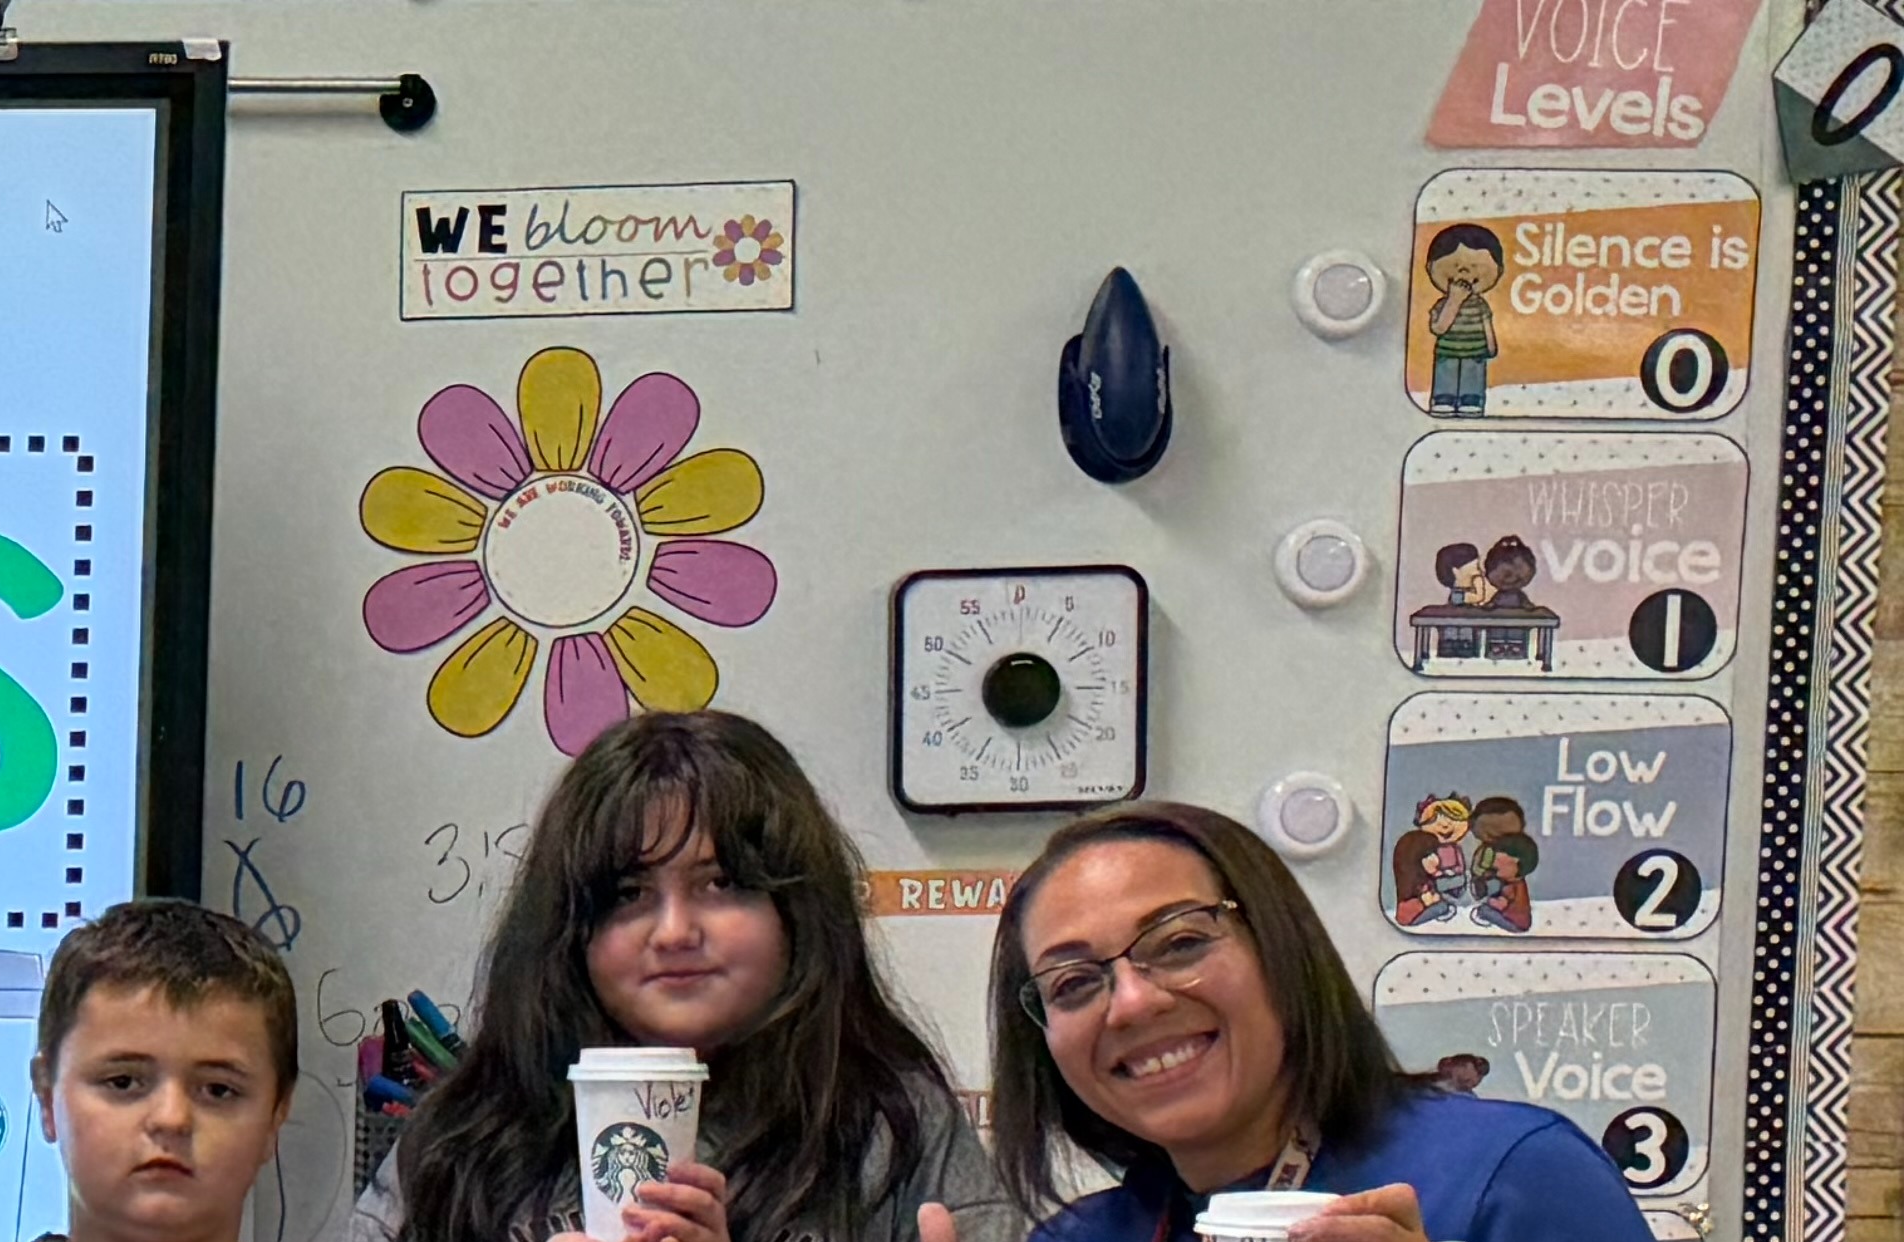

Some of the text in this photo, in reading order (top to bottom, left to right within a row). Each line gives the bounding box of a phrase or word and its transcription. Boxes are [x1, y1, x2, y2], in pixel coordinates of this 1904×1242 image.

[1514, 0, 1680, 73] VOICE
[1490, 63, 1706, 141] Levels
[415, 199, 712, 255] WE bloom
[1513, 222, 1750, 270] Silence is
[421, 257, 710, 306] together
[1508, 274, 1682, 318] Golden
[1654, 332, 1714, 408] 0
[497, 508, 518, 530] WE
[545, 480, 606, 506] WORKING
[1527, 480, 1690, 529] WHISPER
[1541, 525, 1722, 585] voice
[960, 600, 982, 616] 55
[1664, 594, 1682, 668] 1
[1098, 629, 1117, 648] 10
[1111, 681, 1130, 695] 15
[922, 731, 944, 748] 40
[1096, 727, 1116, 742] 20
[1557, 736, 1669, 786] Low
[1540, 784, 1679, 840] Flow
[899, 878, 1008, 910] REWA
[1633, 855, 1680, 929] 2
[1487, 1001, 1653, 1050] SPEAKER
[1512, 1050, 1669, 1102] Voice
[1621, 1111, 1667, 1185] 3
